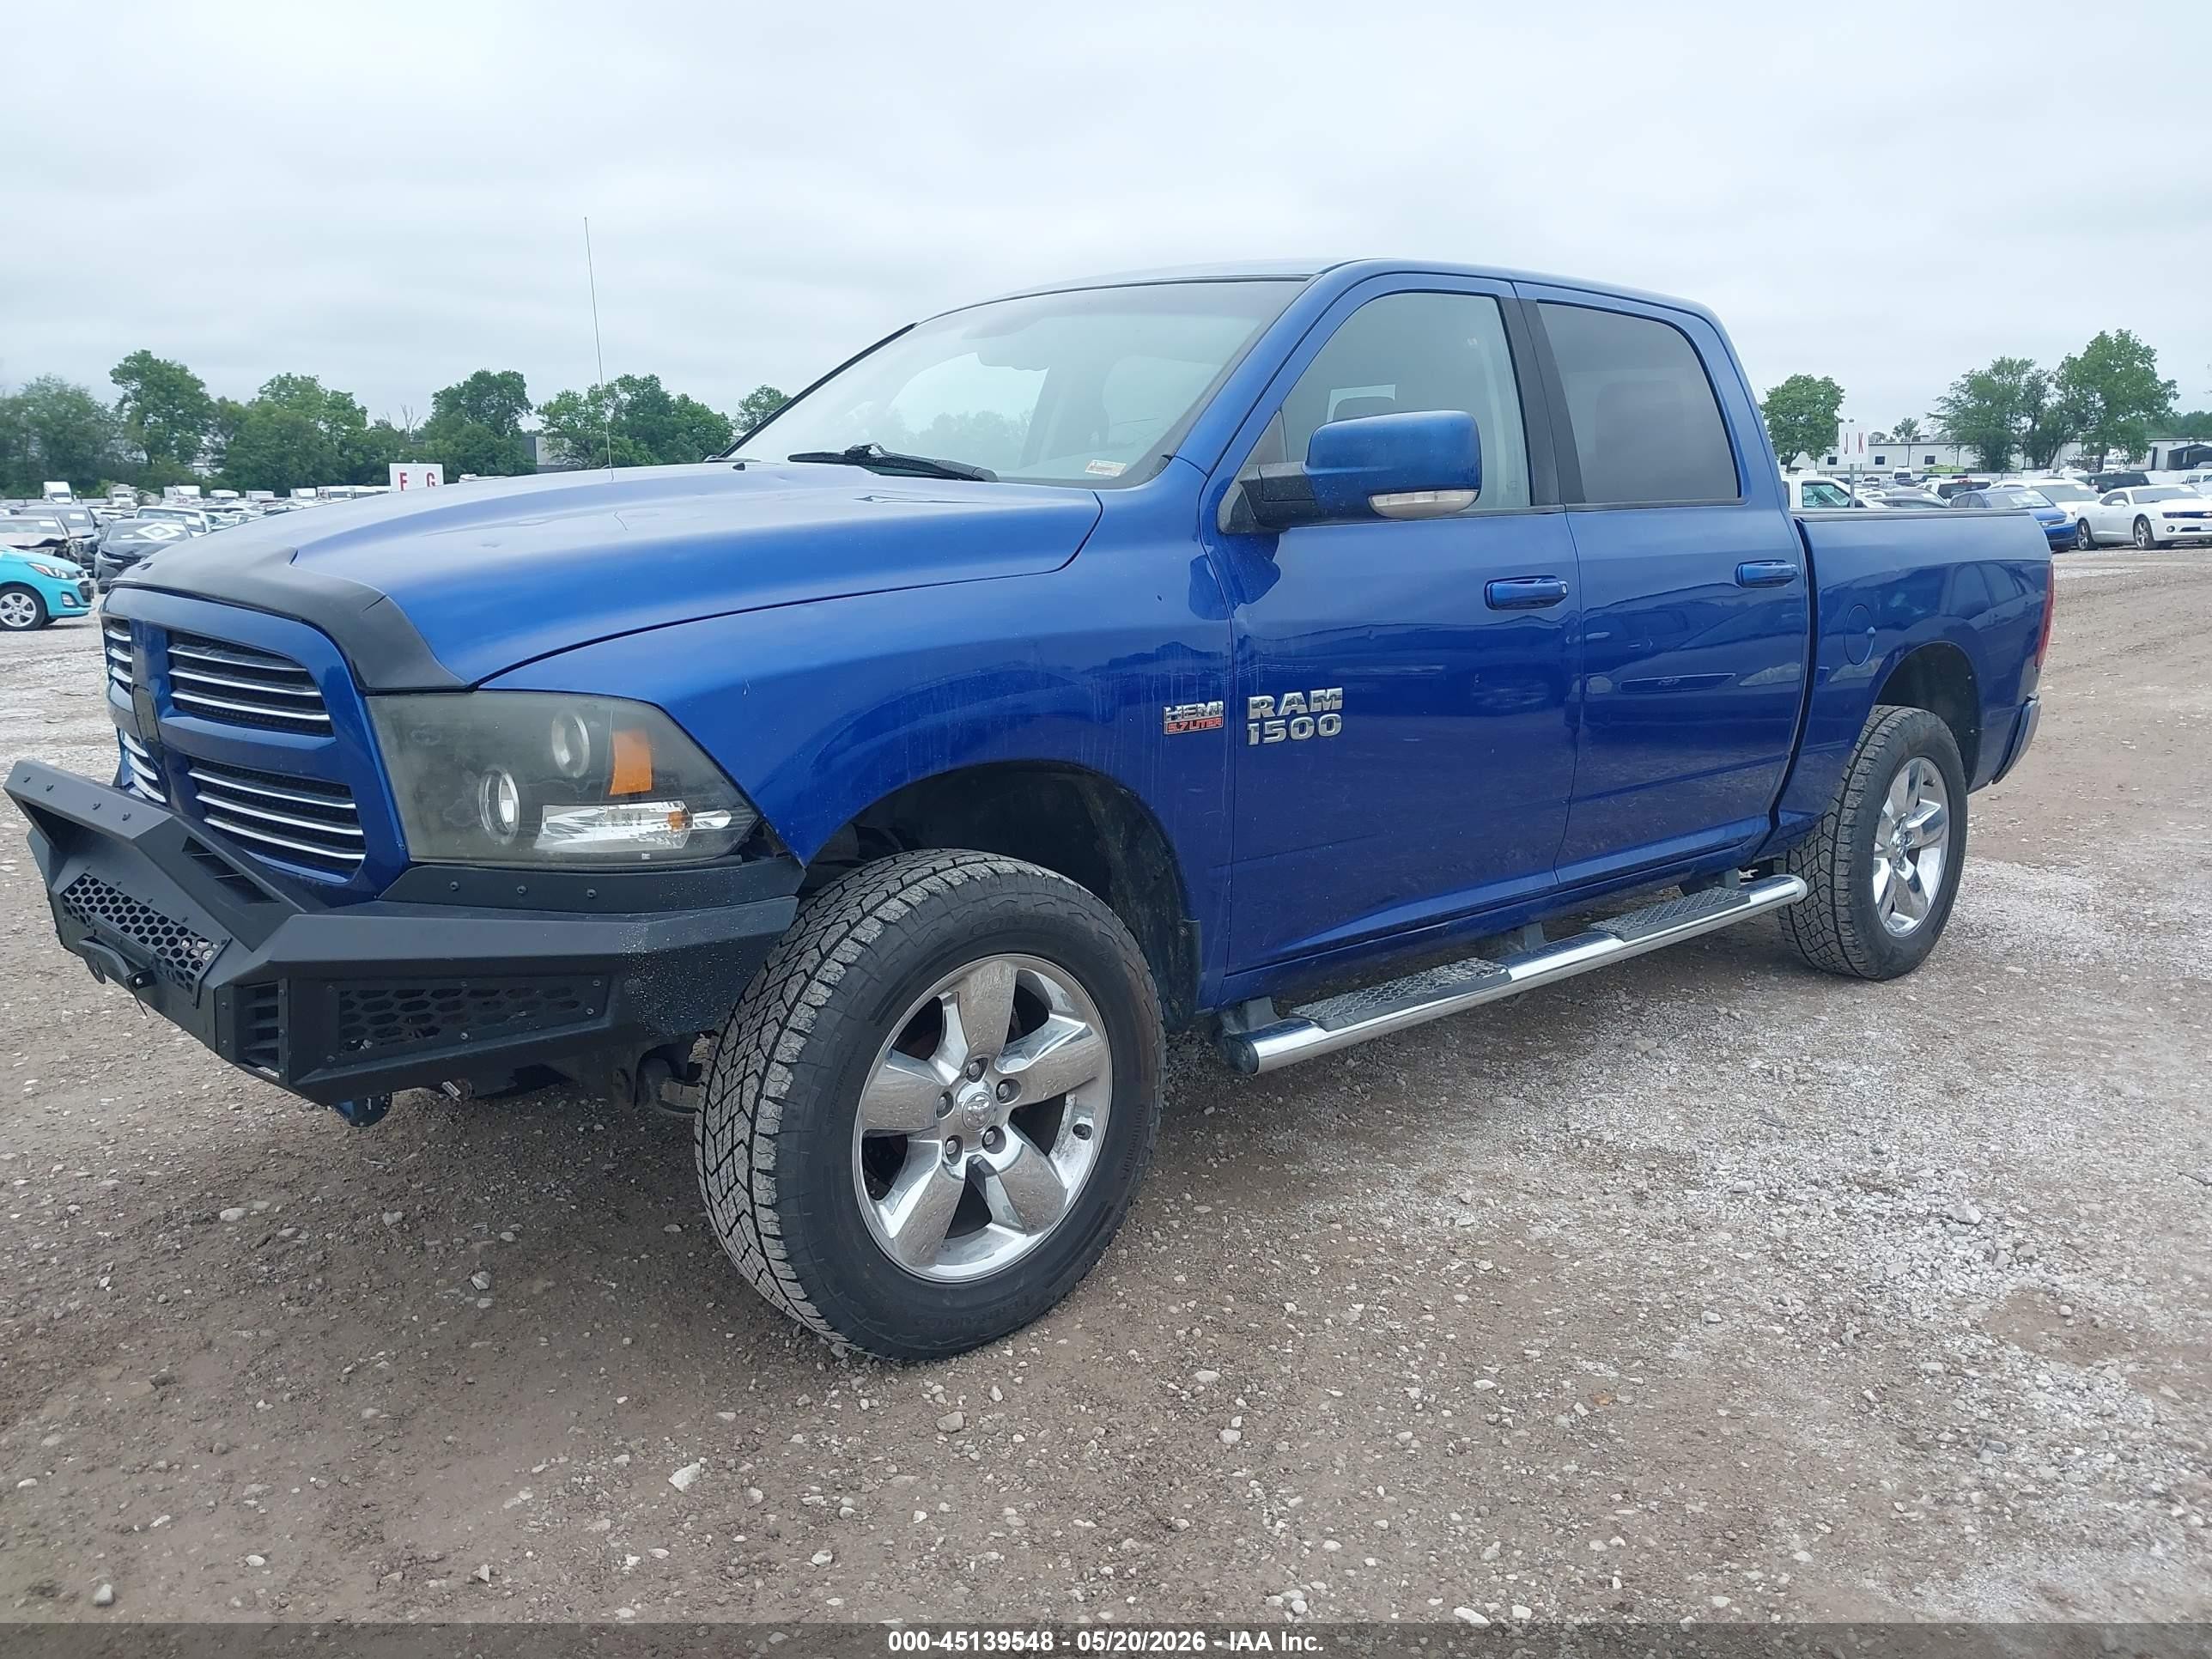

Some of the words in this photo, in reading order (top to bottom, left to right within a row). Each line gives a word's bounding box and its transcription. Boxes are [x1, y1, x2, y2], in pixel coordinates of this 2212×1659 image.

[1844, 432, 1849, 455] J
[1857, 432, 1864, 454] K
[399, 472, 408, 491] F
[427, 472, 435, 488] G
[1164, 701, 1224, 720] HEMI
[1247, 687, 1343, 720] RAM
[1167, 720, 1188, 733] 5.7
[1188, 717, 1222, 731] LITER
[1247, 713, 1342, 745] 1500
